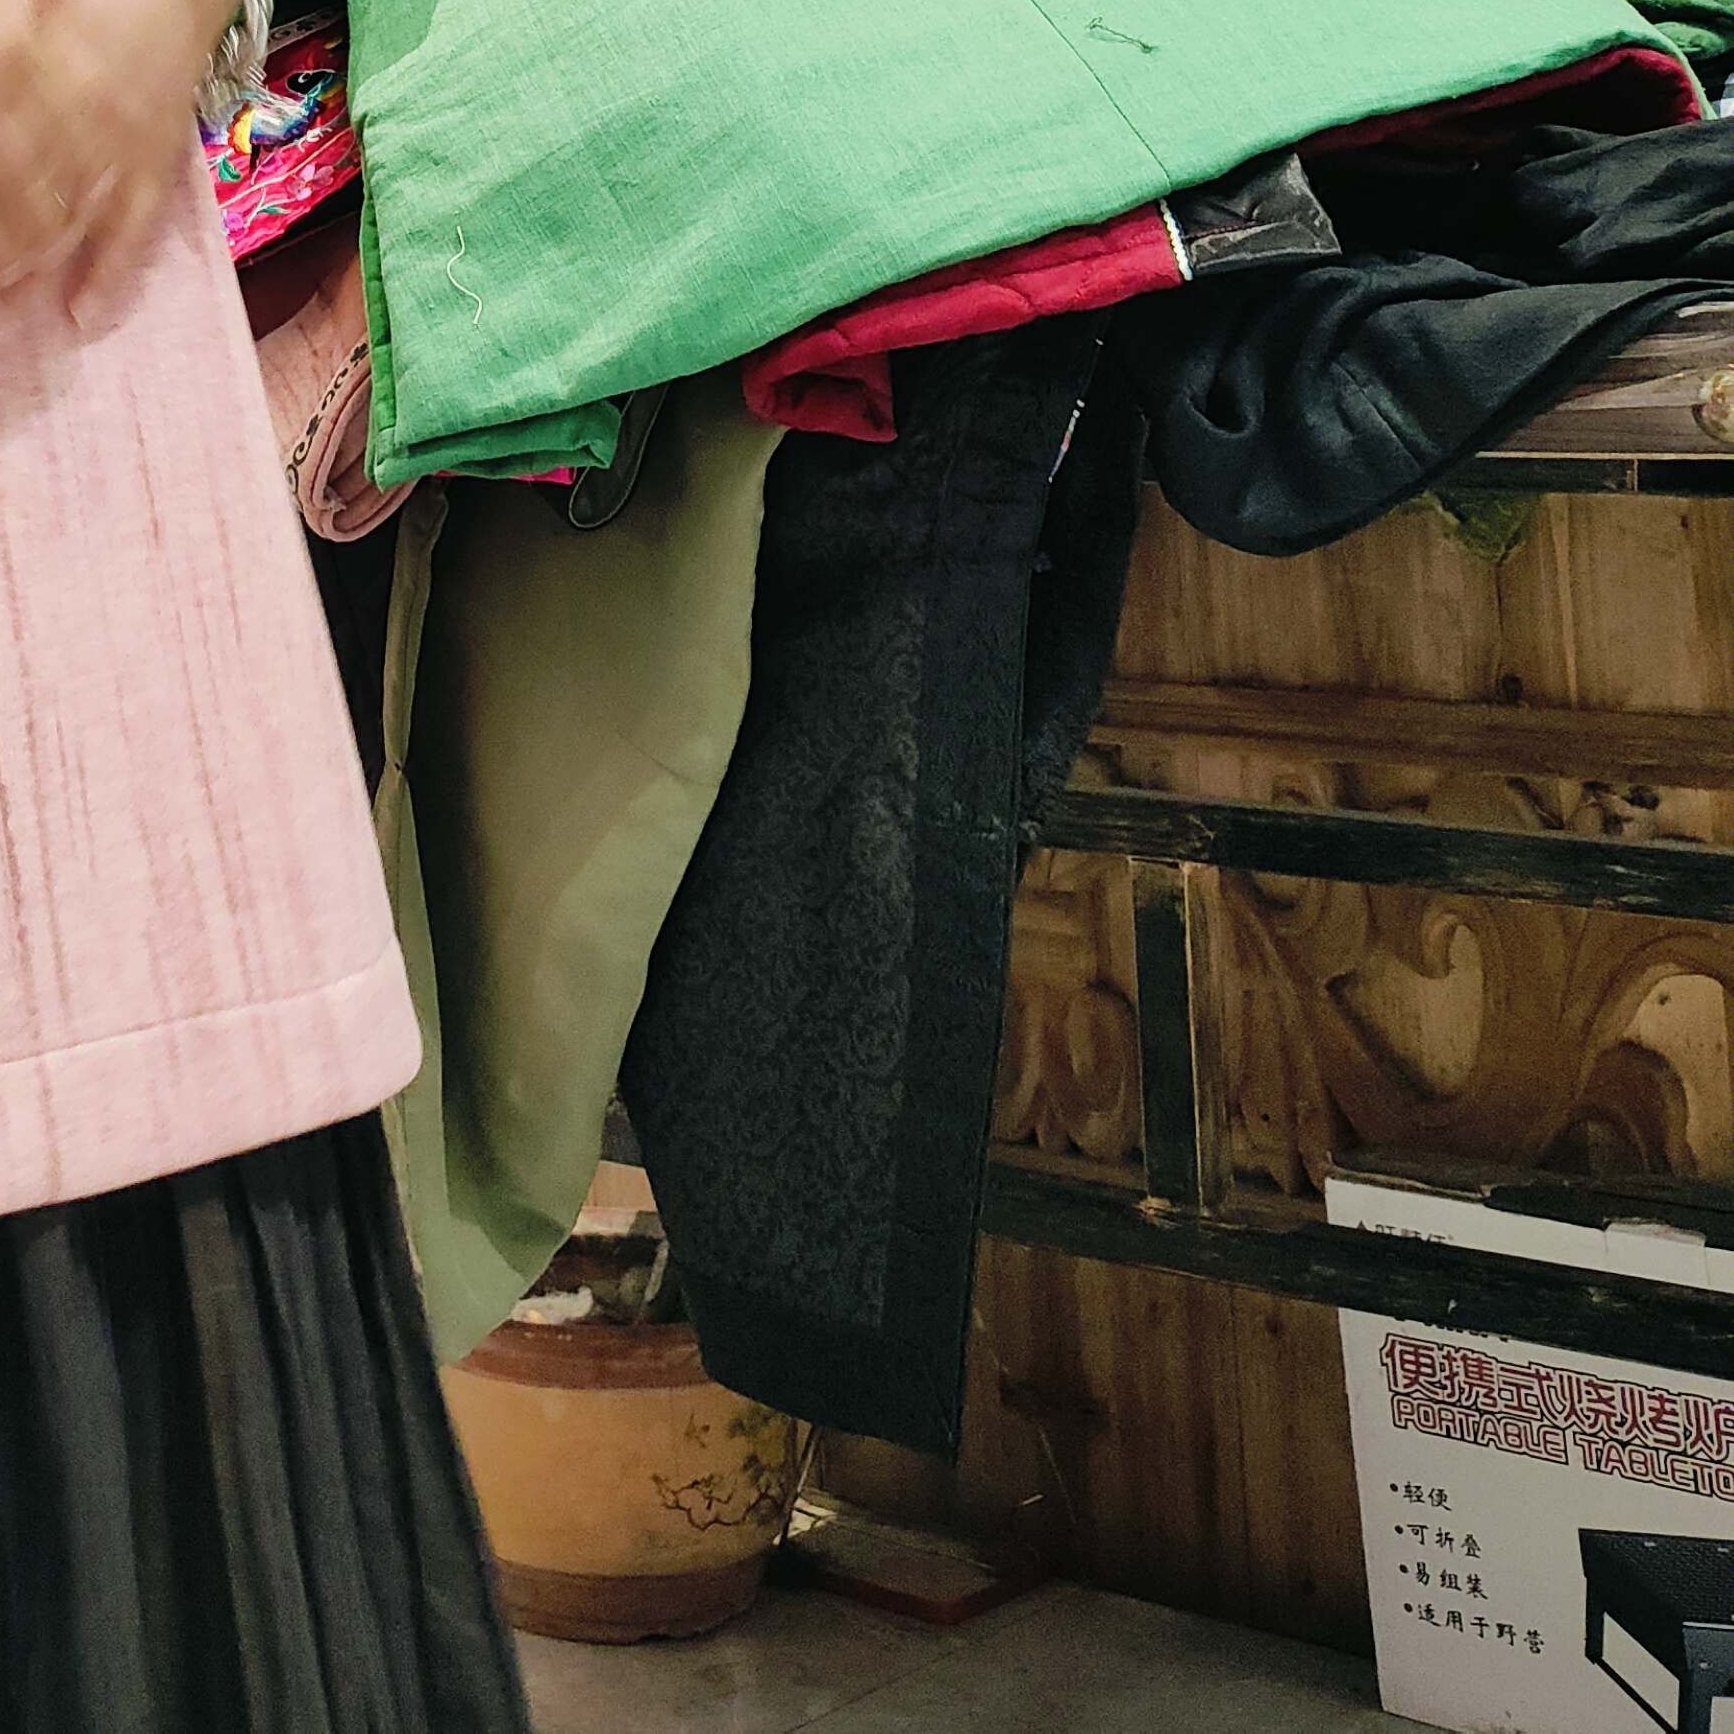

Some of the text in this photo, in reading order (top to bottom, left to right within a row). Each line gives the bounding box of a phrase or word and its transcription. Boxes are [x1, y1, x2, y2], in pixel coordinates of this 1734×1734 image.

[1381, 1334, 1734, 1460] 便携式烧烤炉
[1393, 1395, 1734, 1500] PORTABLE TABLETO
[1403, 1481, 1452, 1511] 轻便
[1406, 1524, 1482, 1559] 可折叠
[1415, 1562, 1489, 1600] 易组装
[1417, 1603, 1545, 1655] 适用于野营
